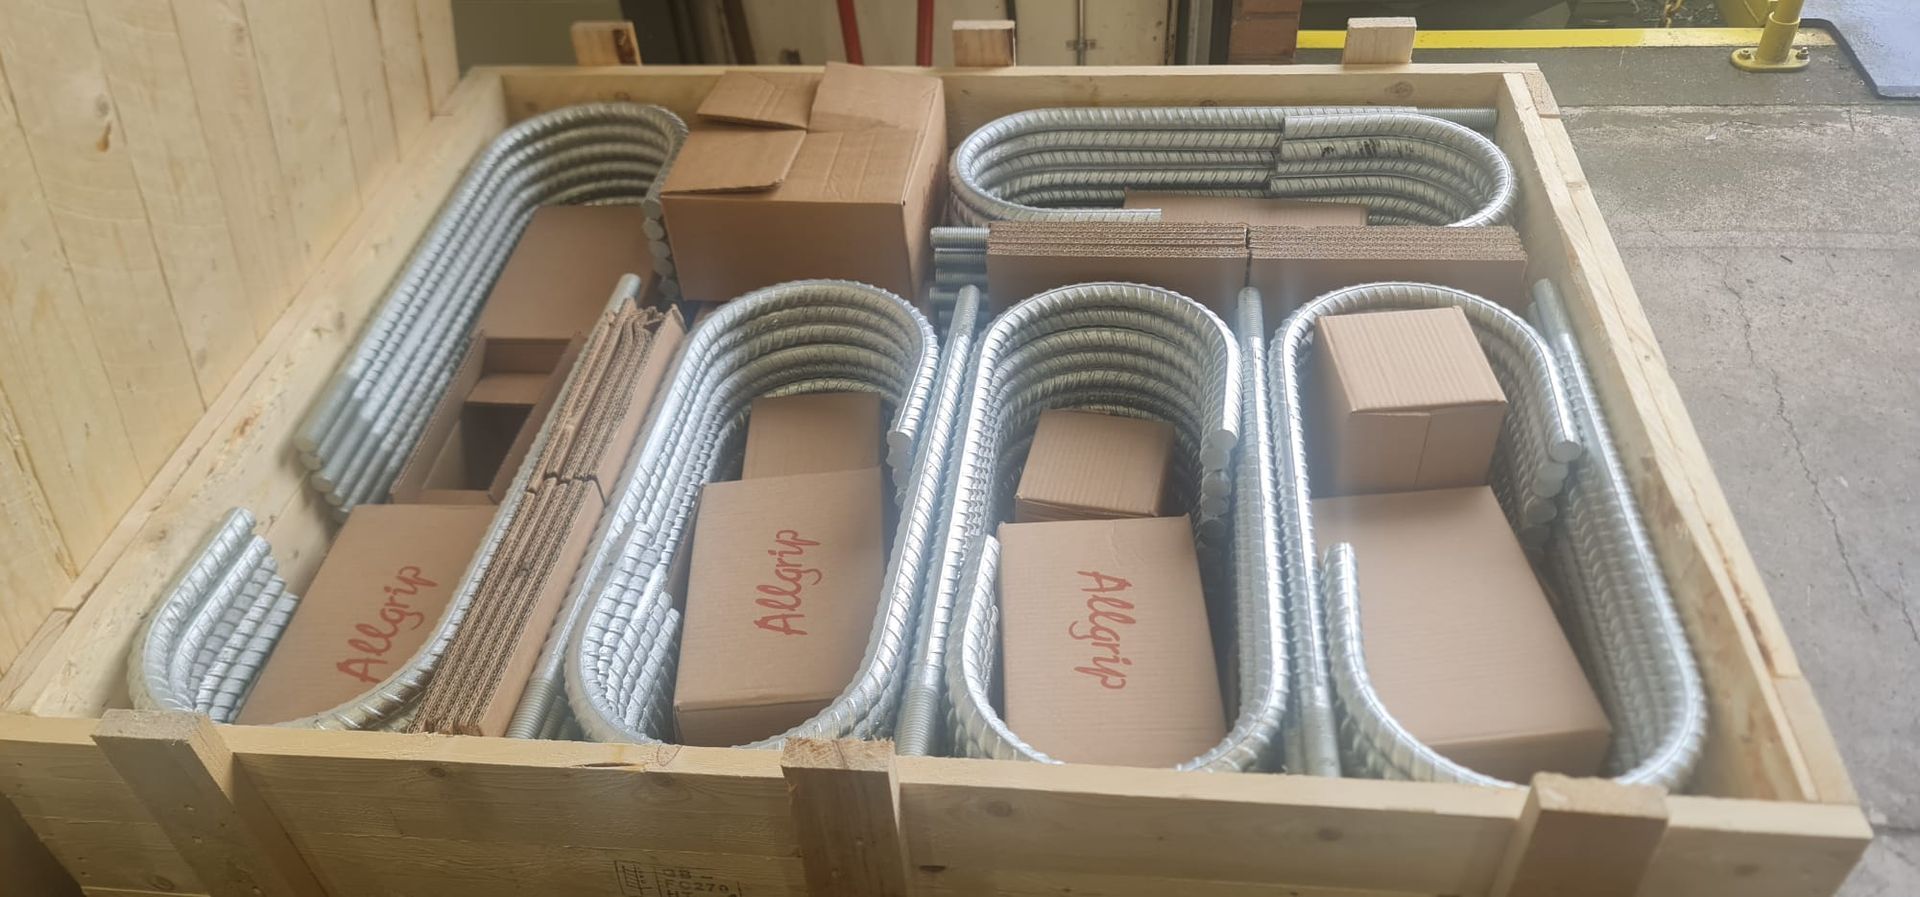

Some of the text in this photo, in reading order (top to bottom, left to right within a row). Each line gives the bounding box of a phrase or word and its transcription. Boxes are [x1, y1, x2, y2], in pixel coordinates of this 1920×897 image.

[337, 565, 439, 683] Allgrip
[754, 529, 821, 636] Allgrip
[1069, 570, 1137, 689] Allgrip
